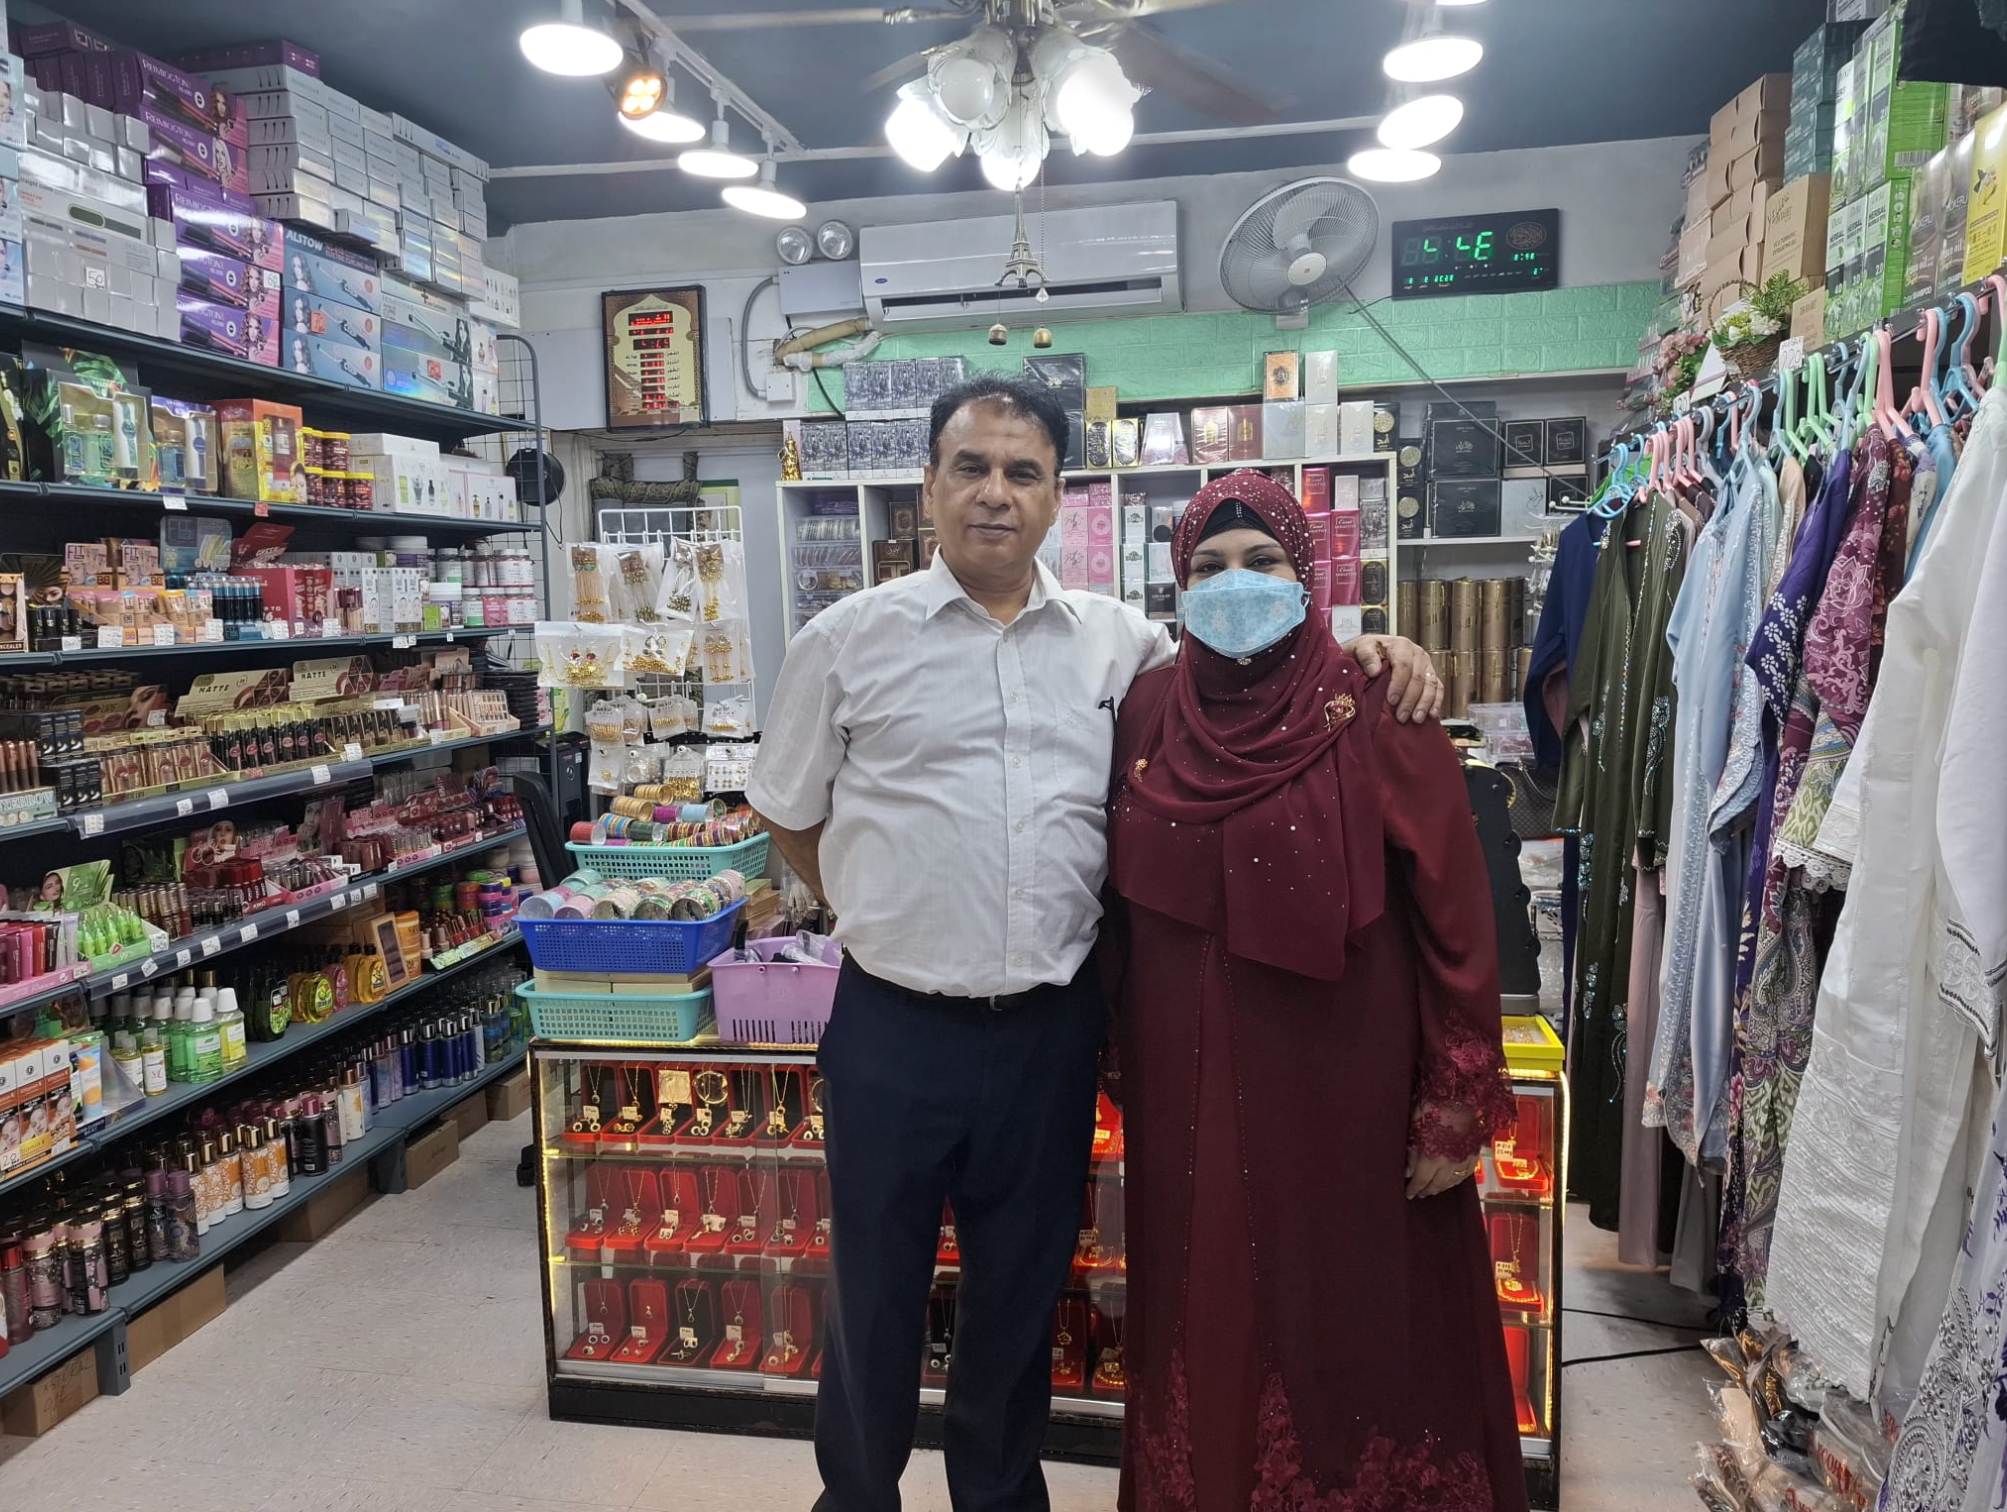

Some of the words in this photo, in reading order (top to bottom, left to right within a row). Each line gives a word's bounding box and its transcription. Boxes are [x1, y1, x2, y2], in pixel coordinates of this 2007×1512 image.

[286, 230, 323, 251] ALSTOW
[301, 671, 326, 680] MATTE
[199, 685, 230, 694] MATTE
